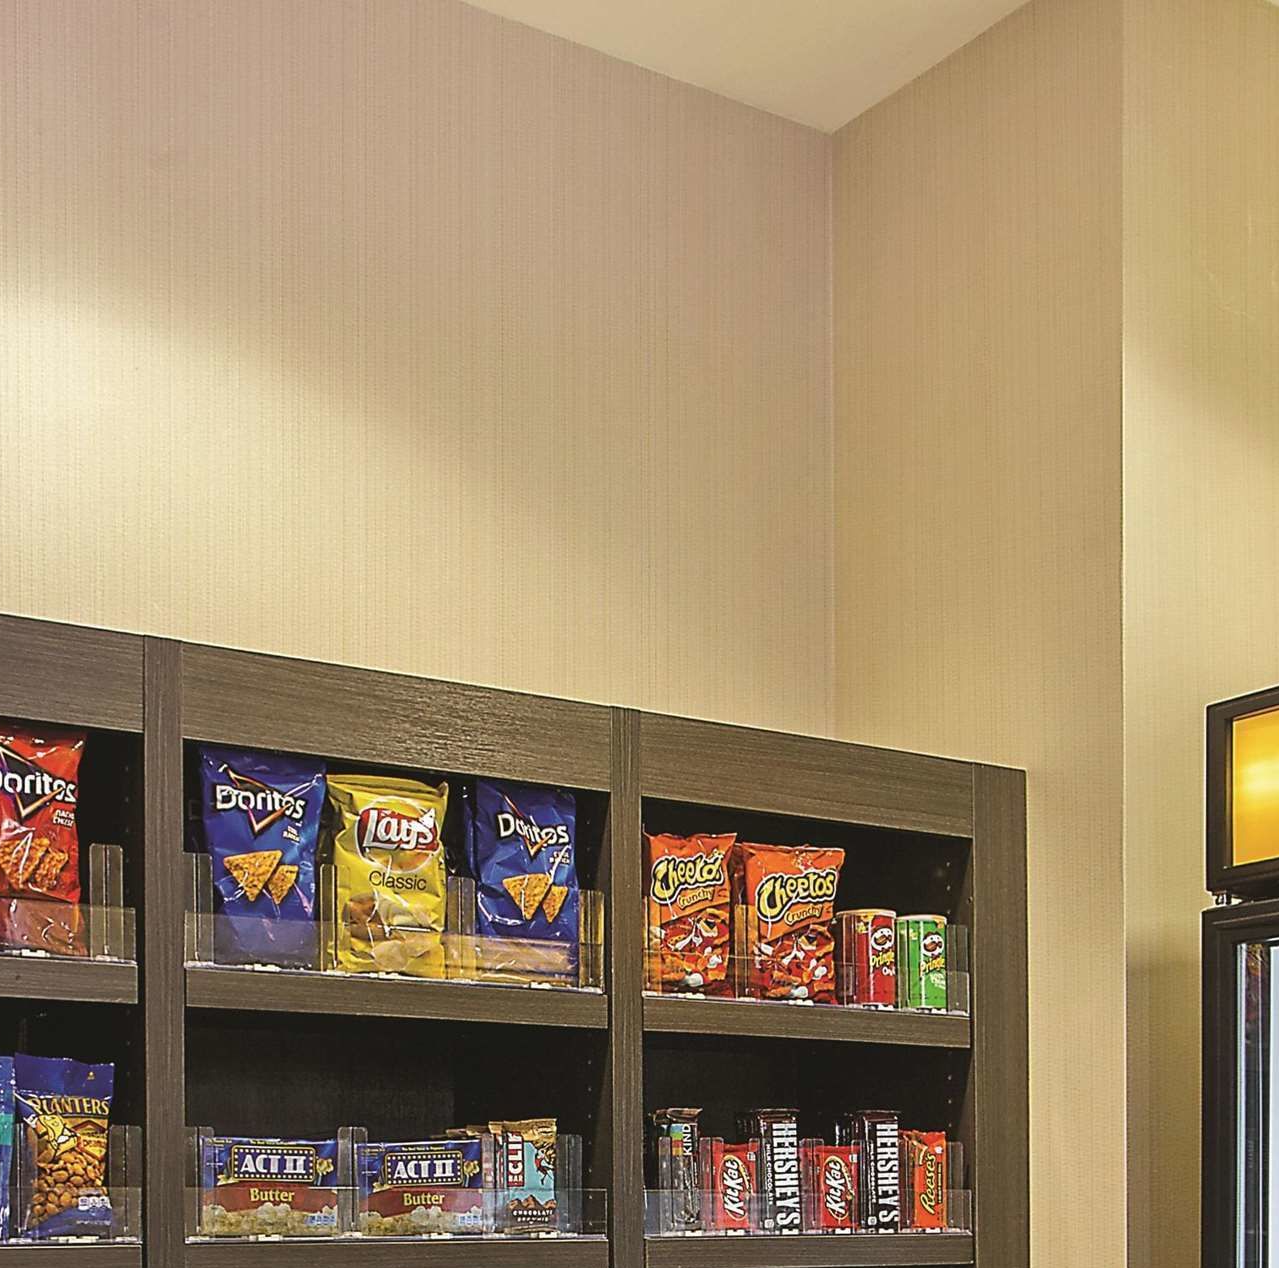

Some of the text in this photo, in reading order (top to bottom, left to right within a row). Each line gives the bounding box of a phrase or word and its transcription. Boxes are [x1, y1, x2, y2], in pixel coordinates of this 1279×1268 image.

[216, 784, 307, 821] Doritos
[497, 812, 570, 846] Doritos
[369, 870, 427, 891] Classic
[652, 853, 723, 902] Cheeto
[678, 887, 716, 909] Crunchy
[757, 870, 837, 919] Cheetos
[785, 903, 824, 926] Crunchy
[30, 1097, 110, 1116] PLANTERS
[683, 1123, 692, 1156] KIND
[240, 1154, 307, 1174] ACT II
[393, 1159, 455, 1179] ACT II
[772, 1122, 800, 1226] HERSHEY'S
[876, 1123, 900, 1223] HERSHEY'S
[249, 1187, 295, 1202] Butter
[403, 1192, 446, 1206] Butter
